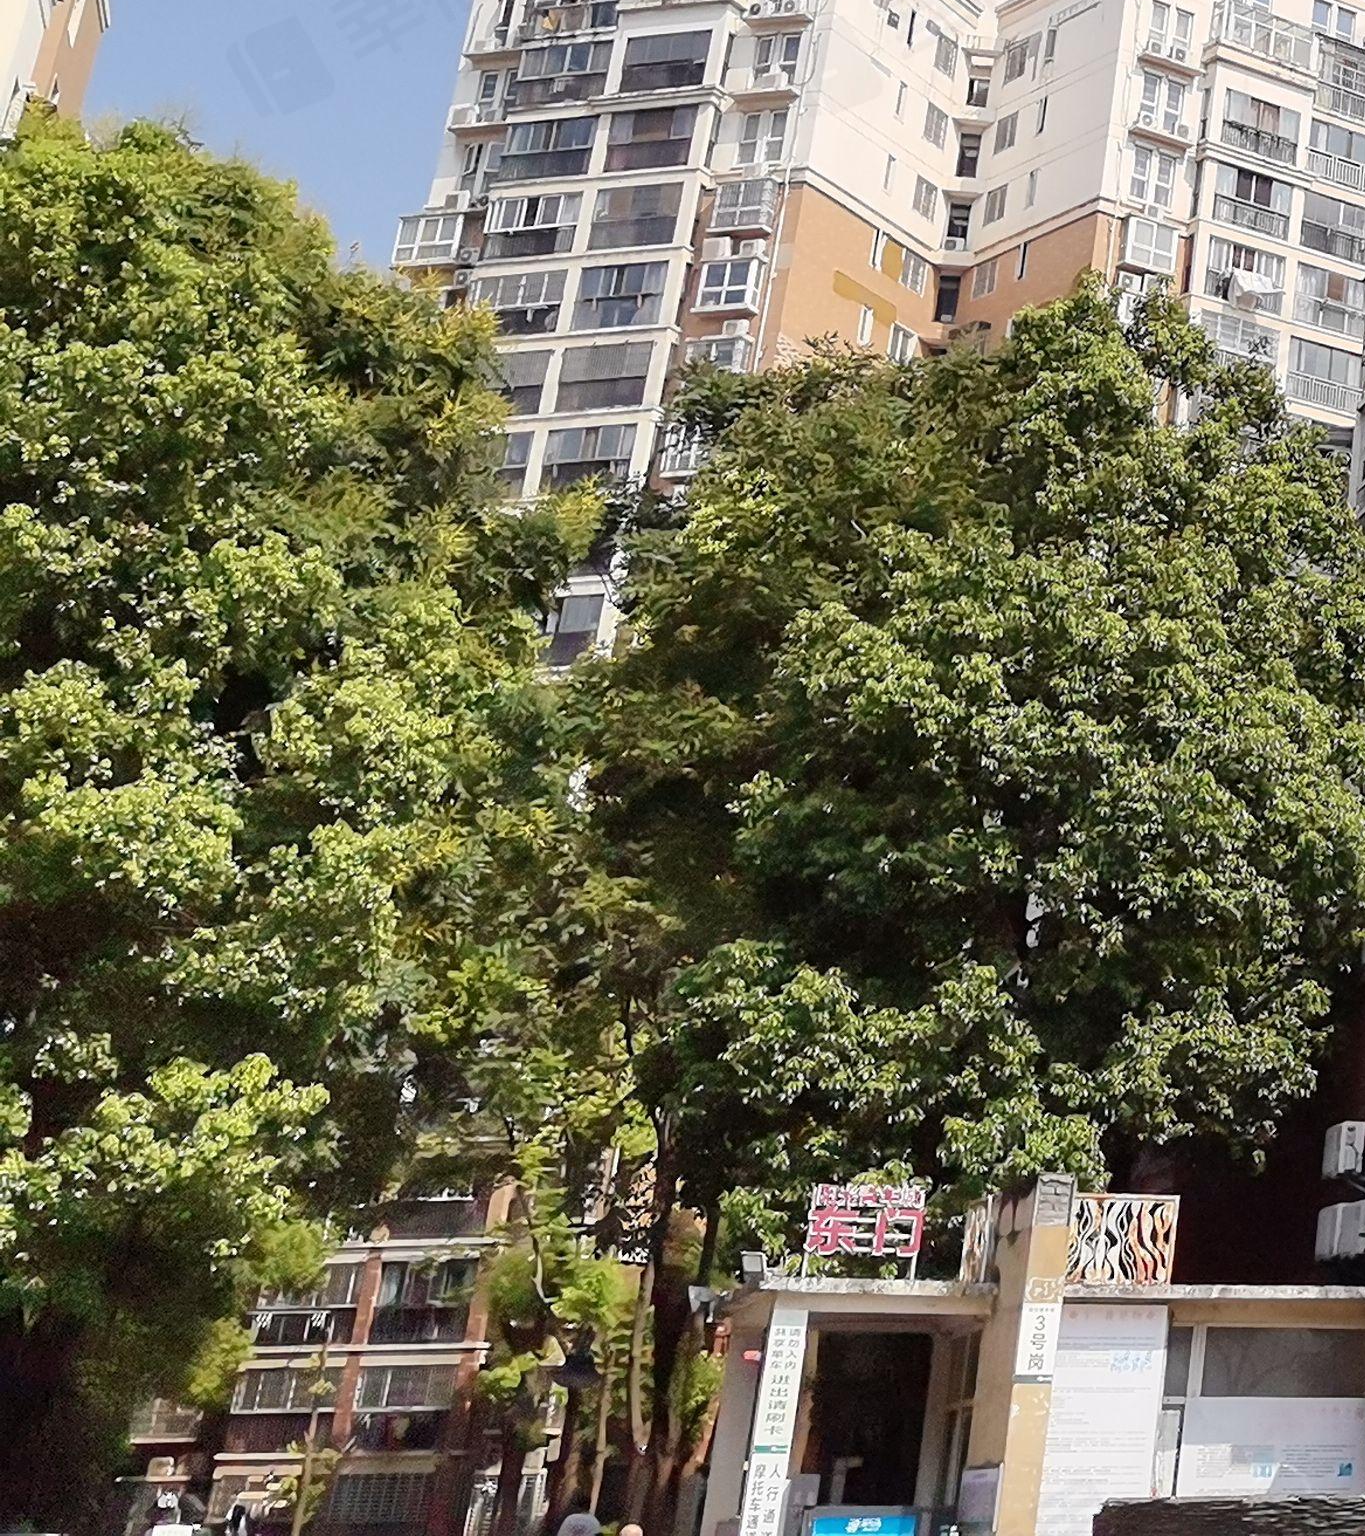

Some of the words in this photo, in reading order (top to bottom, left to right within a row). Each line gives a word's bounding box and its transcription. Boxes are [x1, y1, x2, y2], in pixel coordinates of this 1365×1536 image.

[803, 1205, 924, 1257] 东门
[1028, 1315, 1046, 1371] 3号岗
[763, 1374, 790, 1436] 进出请刷卡
